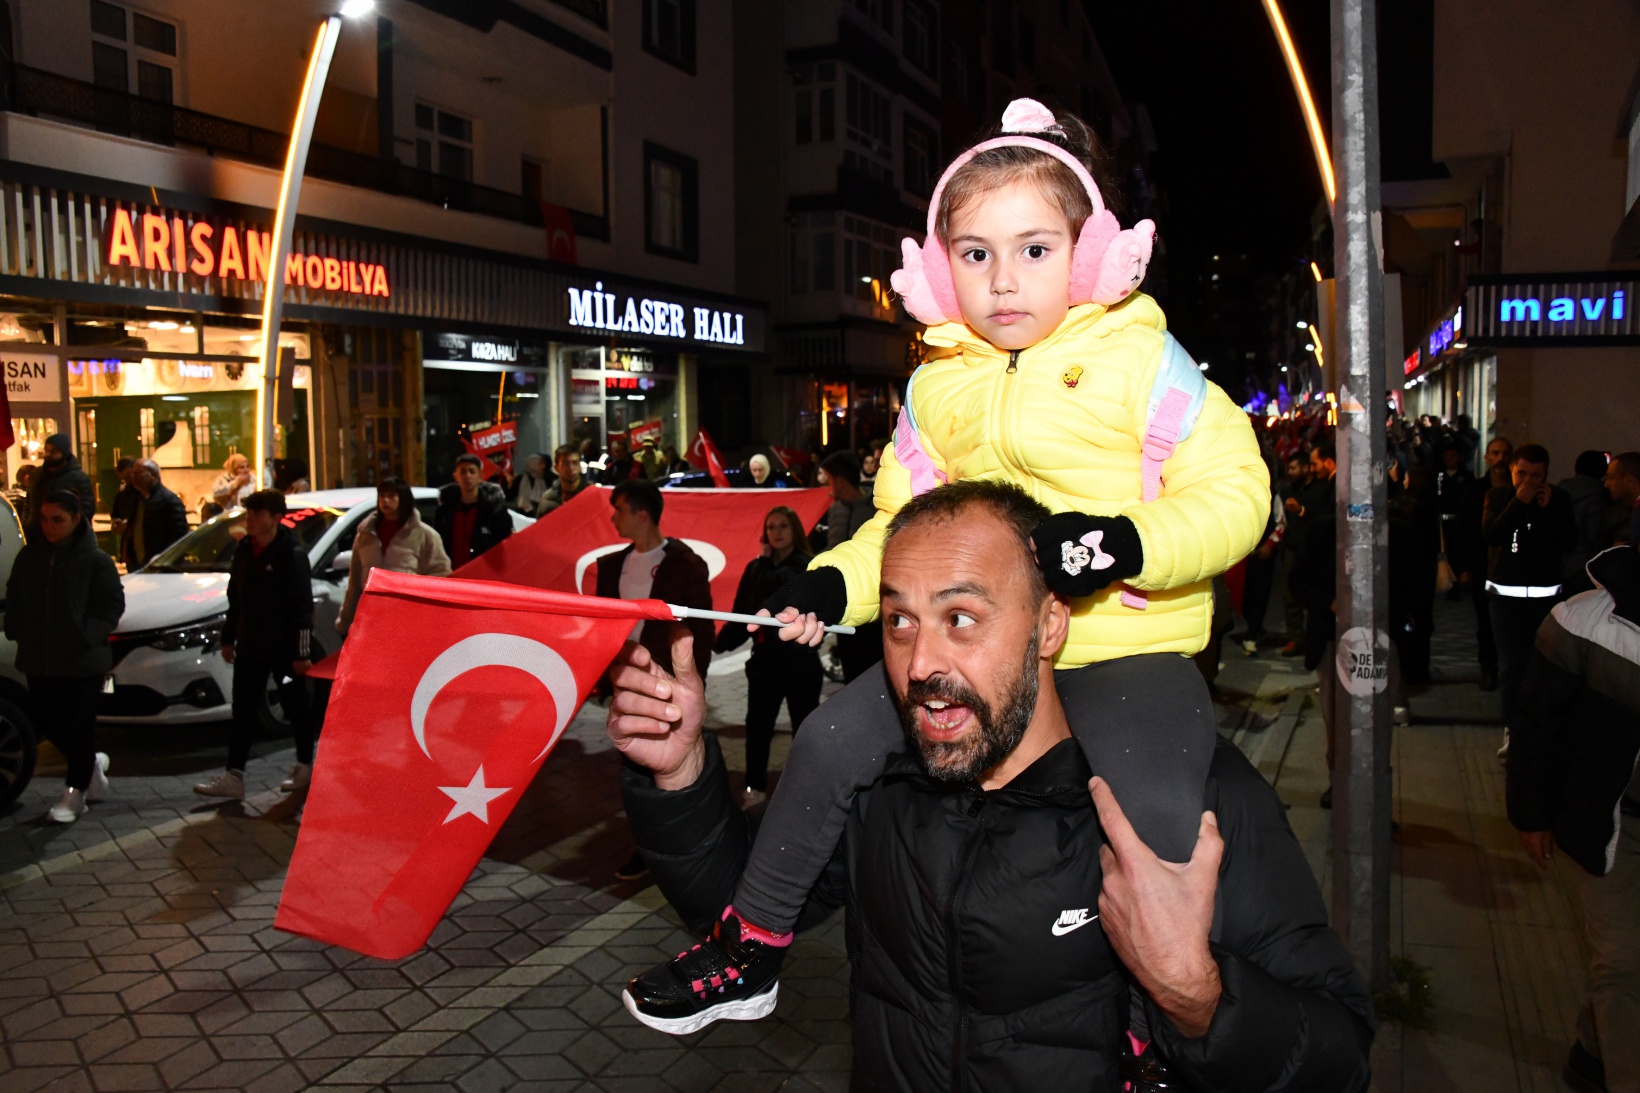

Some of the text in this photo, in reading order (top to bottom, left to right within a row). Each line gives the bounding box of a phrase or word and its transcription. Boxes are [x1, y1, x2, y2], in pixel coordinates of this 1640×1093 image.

[109, 208, 271, 282] ARISAN
[567, 281, 744, 345] MİLASER HALI
[1500, 290, 1624, 322] mavi
[8, 381, 31, 392] tfak
[1058, 908, 1089, 925] NIKE
